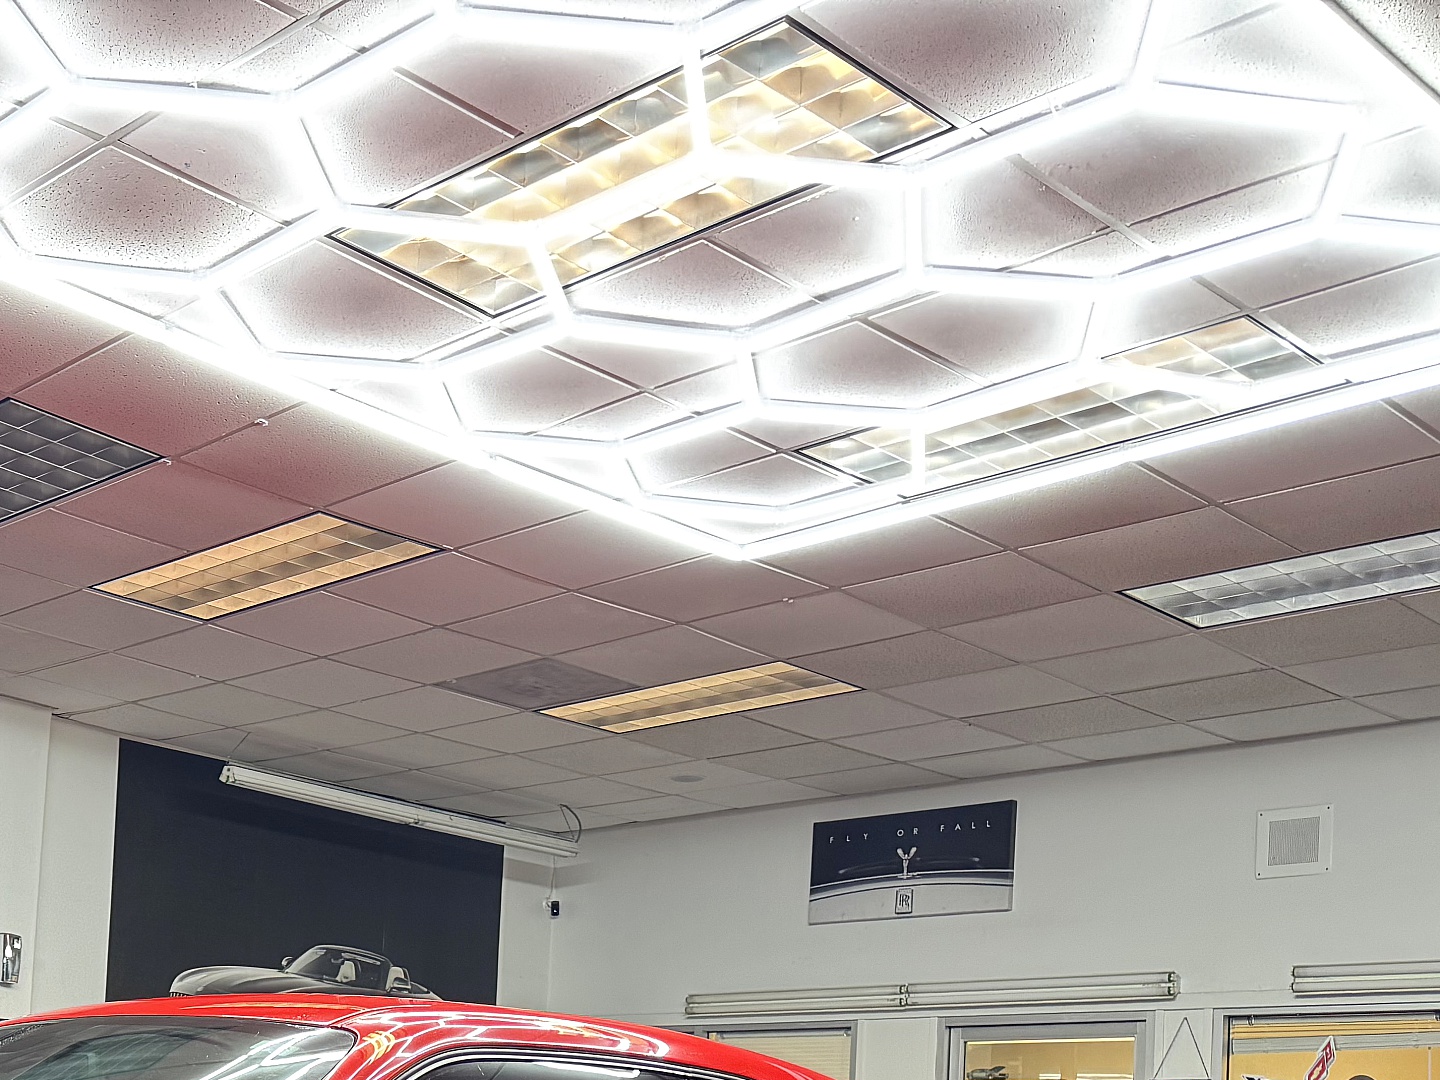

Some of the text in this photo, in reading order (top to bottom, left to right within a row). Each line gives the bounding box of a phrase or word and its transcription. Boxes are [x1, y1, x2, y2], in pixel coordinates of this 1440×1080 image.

[829, 820, 991, 844] FLY OR FALL
